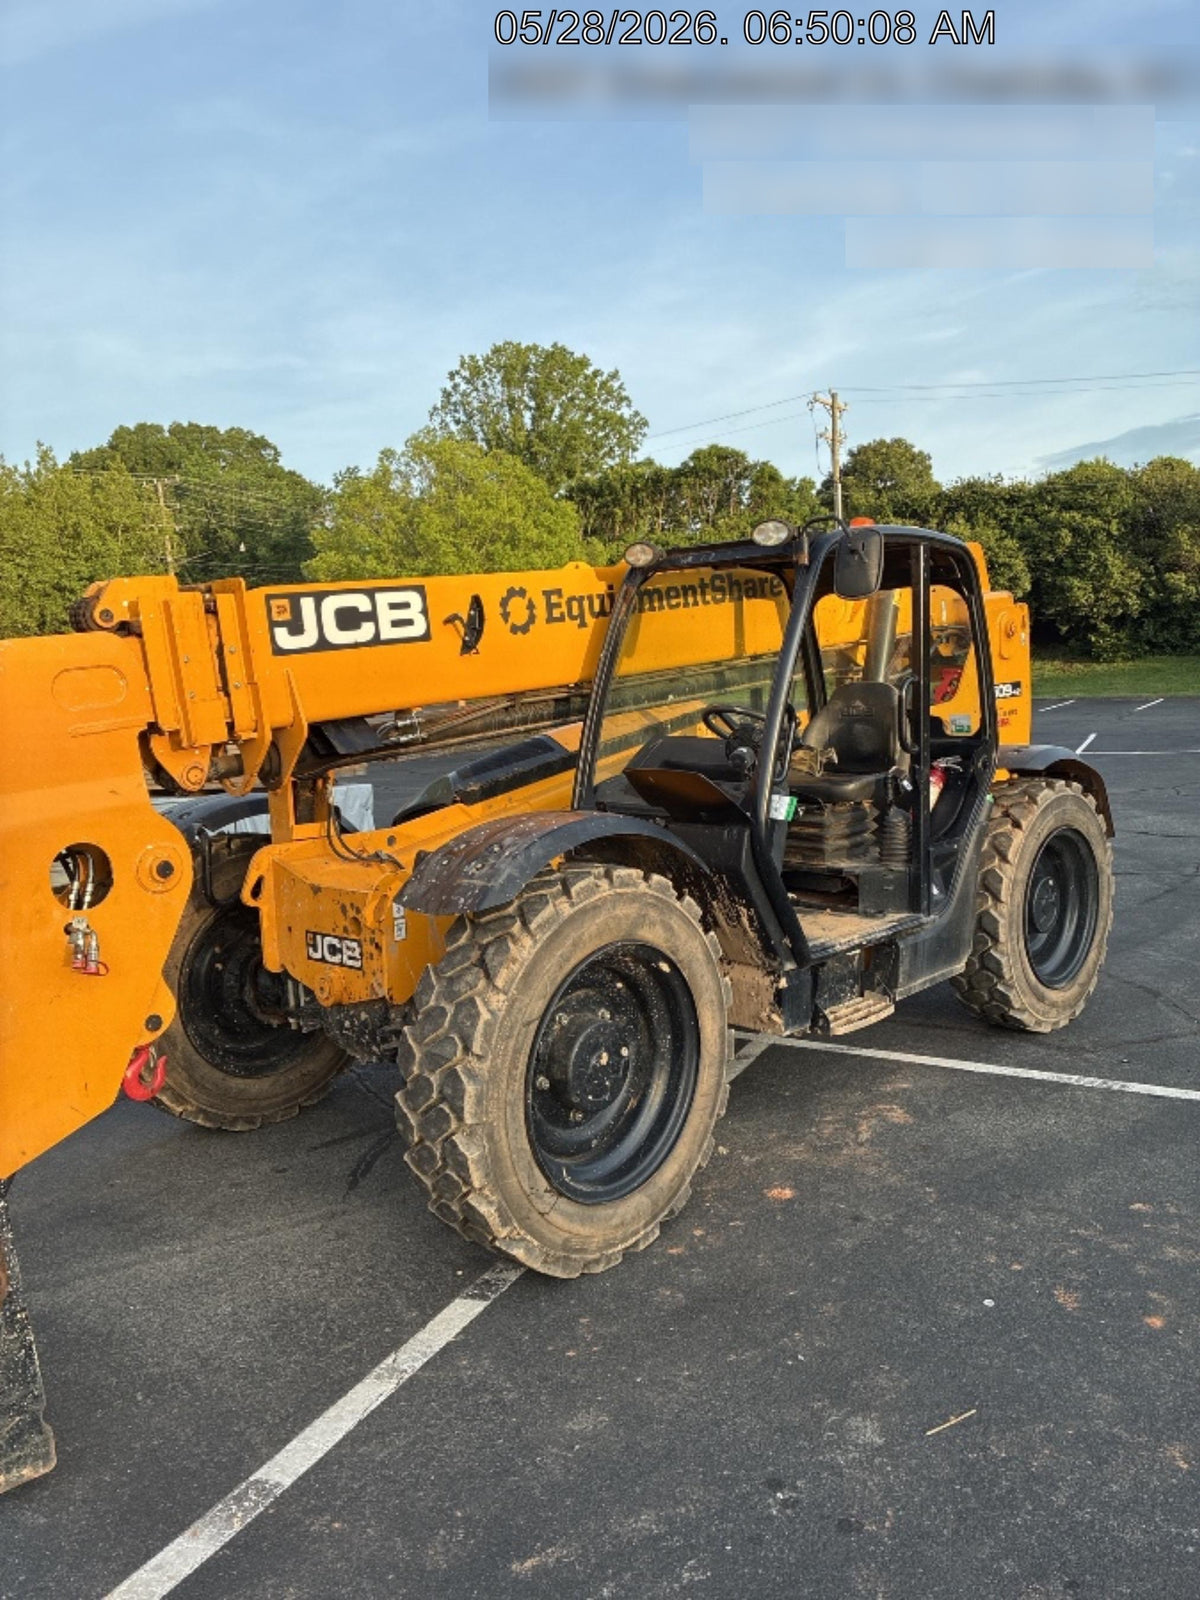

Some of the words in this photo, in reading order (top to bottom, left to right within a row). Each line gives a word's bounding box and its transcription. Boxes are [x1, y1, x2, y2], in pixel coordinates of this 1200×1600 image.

[273, 590, 427, 649] JCB
[542, 573, 783, 629] EquimentShare
[308, 934, 362, 968] JCB
